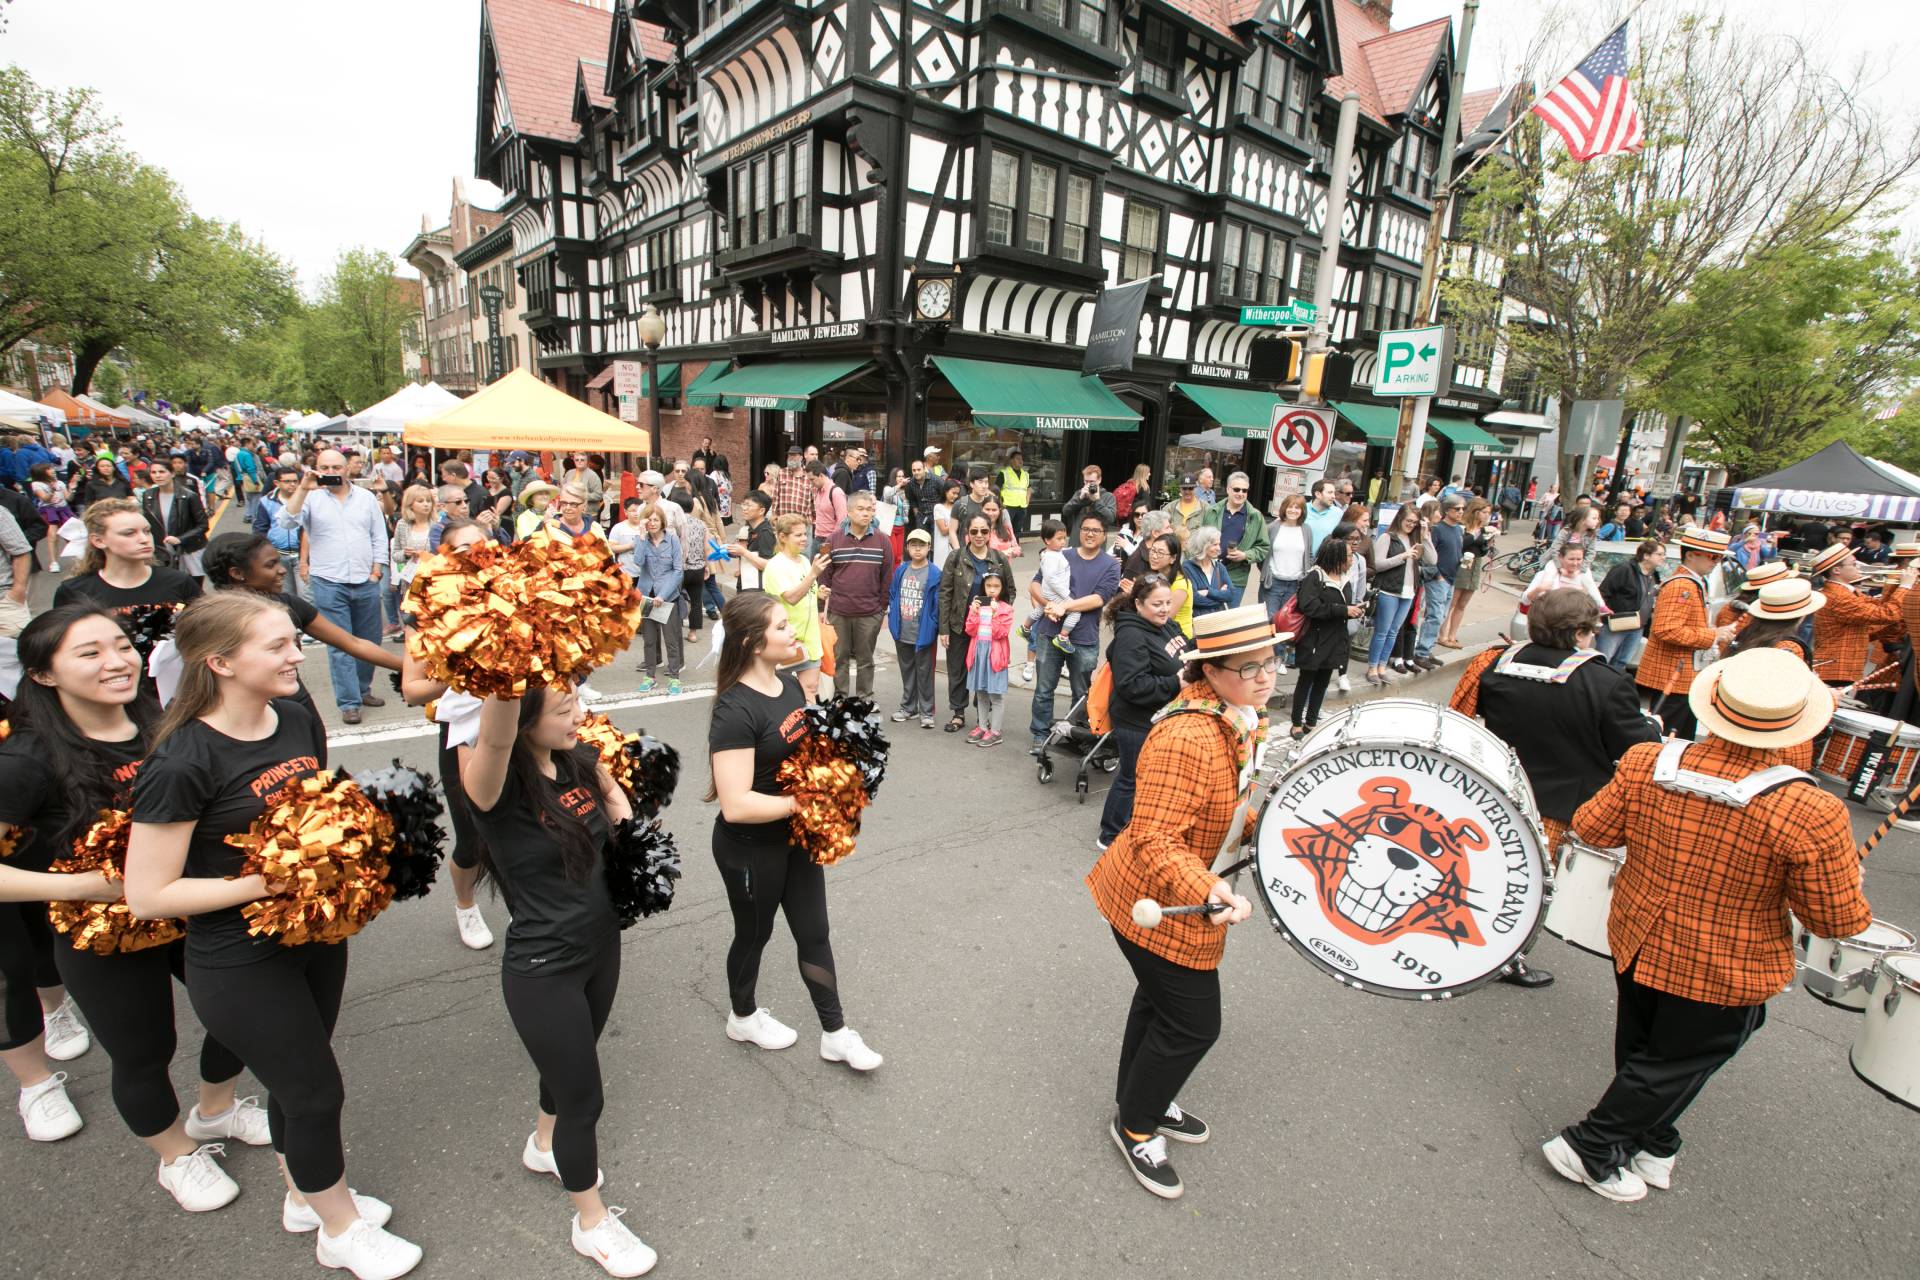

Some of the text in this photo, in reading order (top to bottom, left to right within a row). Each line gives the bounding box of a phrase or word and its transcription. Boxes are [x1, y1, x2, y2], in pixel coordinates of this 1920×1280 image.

[1246, 308, 1292, 322] Witherspoo
[490, 298, 500, 378] RESTAURANT
[772, 322, 858, 343] HAMILTON JEWELERS
[1090, 328, 1127, 341] HAMILTON
[1192, 364, 1232, 378] HAMILTON
[744, 396, 778, 408] HAMILTON
[1036, 416, 1088, 429] HAMILTON
[1789, 494, 1857, 512] Olives
[1278, 778, 1314, 812] THE
[1310, 750, 1438, 786] PRINCETON
[1439, 762, 1530, 878] UNIVERSITY
[1492, 881, 1528, 934] BAND
[1268, 878, 1306, 905] EST
[1315, 940, 1353, 967] EVANS
[1392, 950, 1442, 985] 1919
